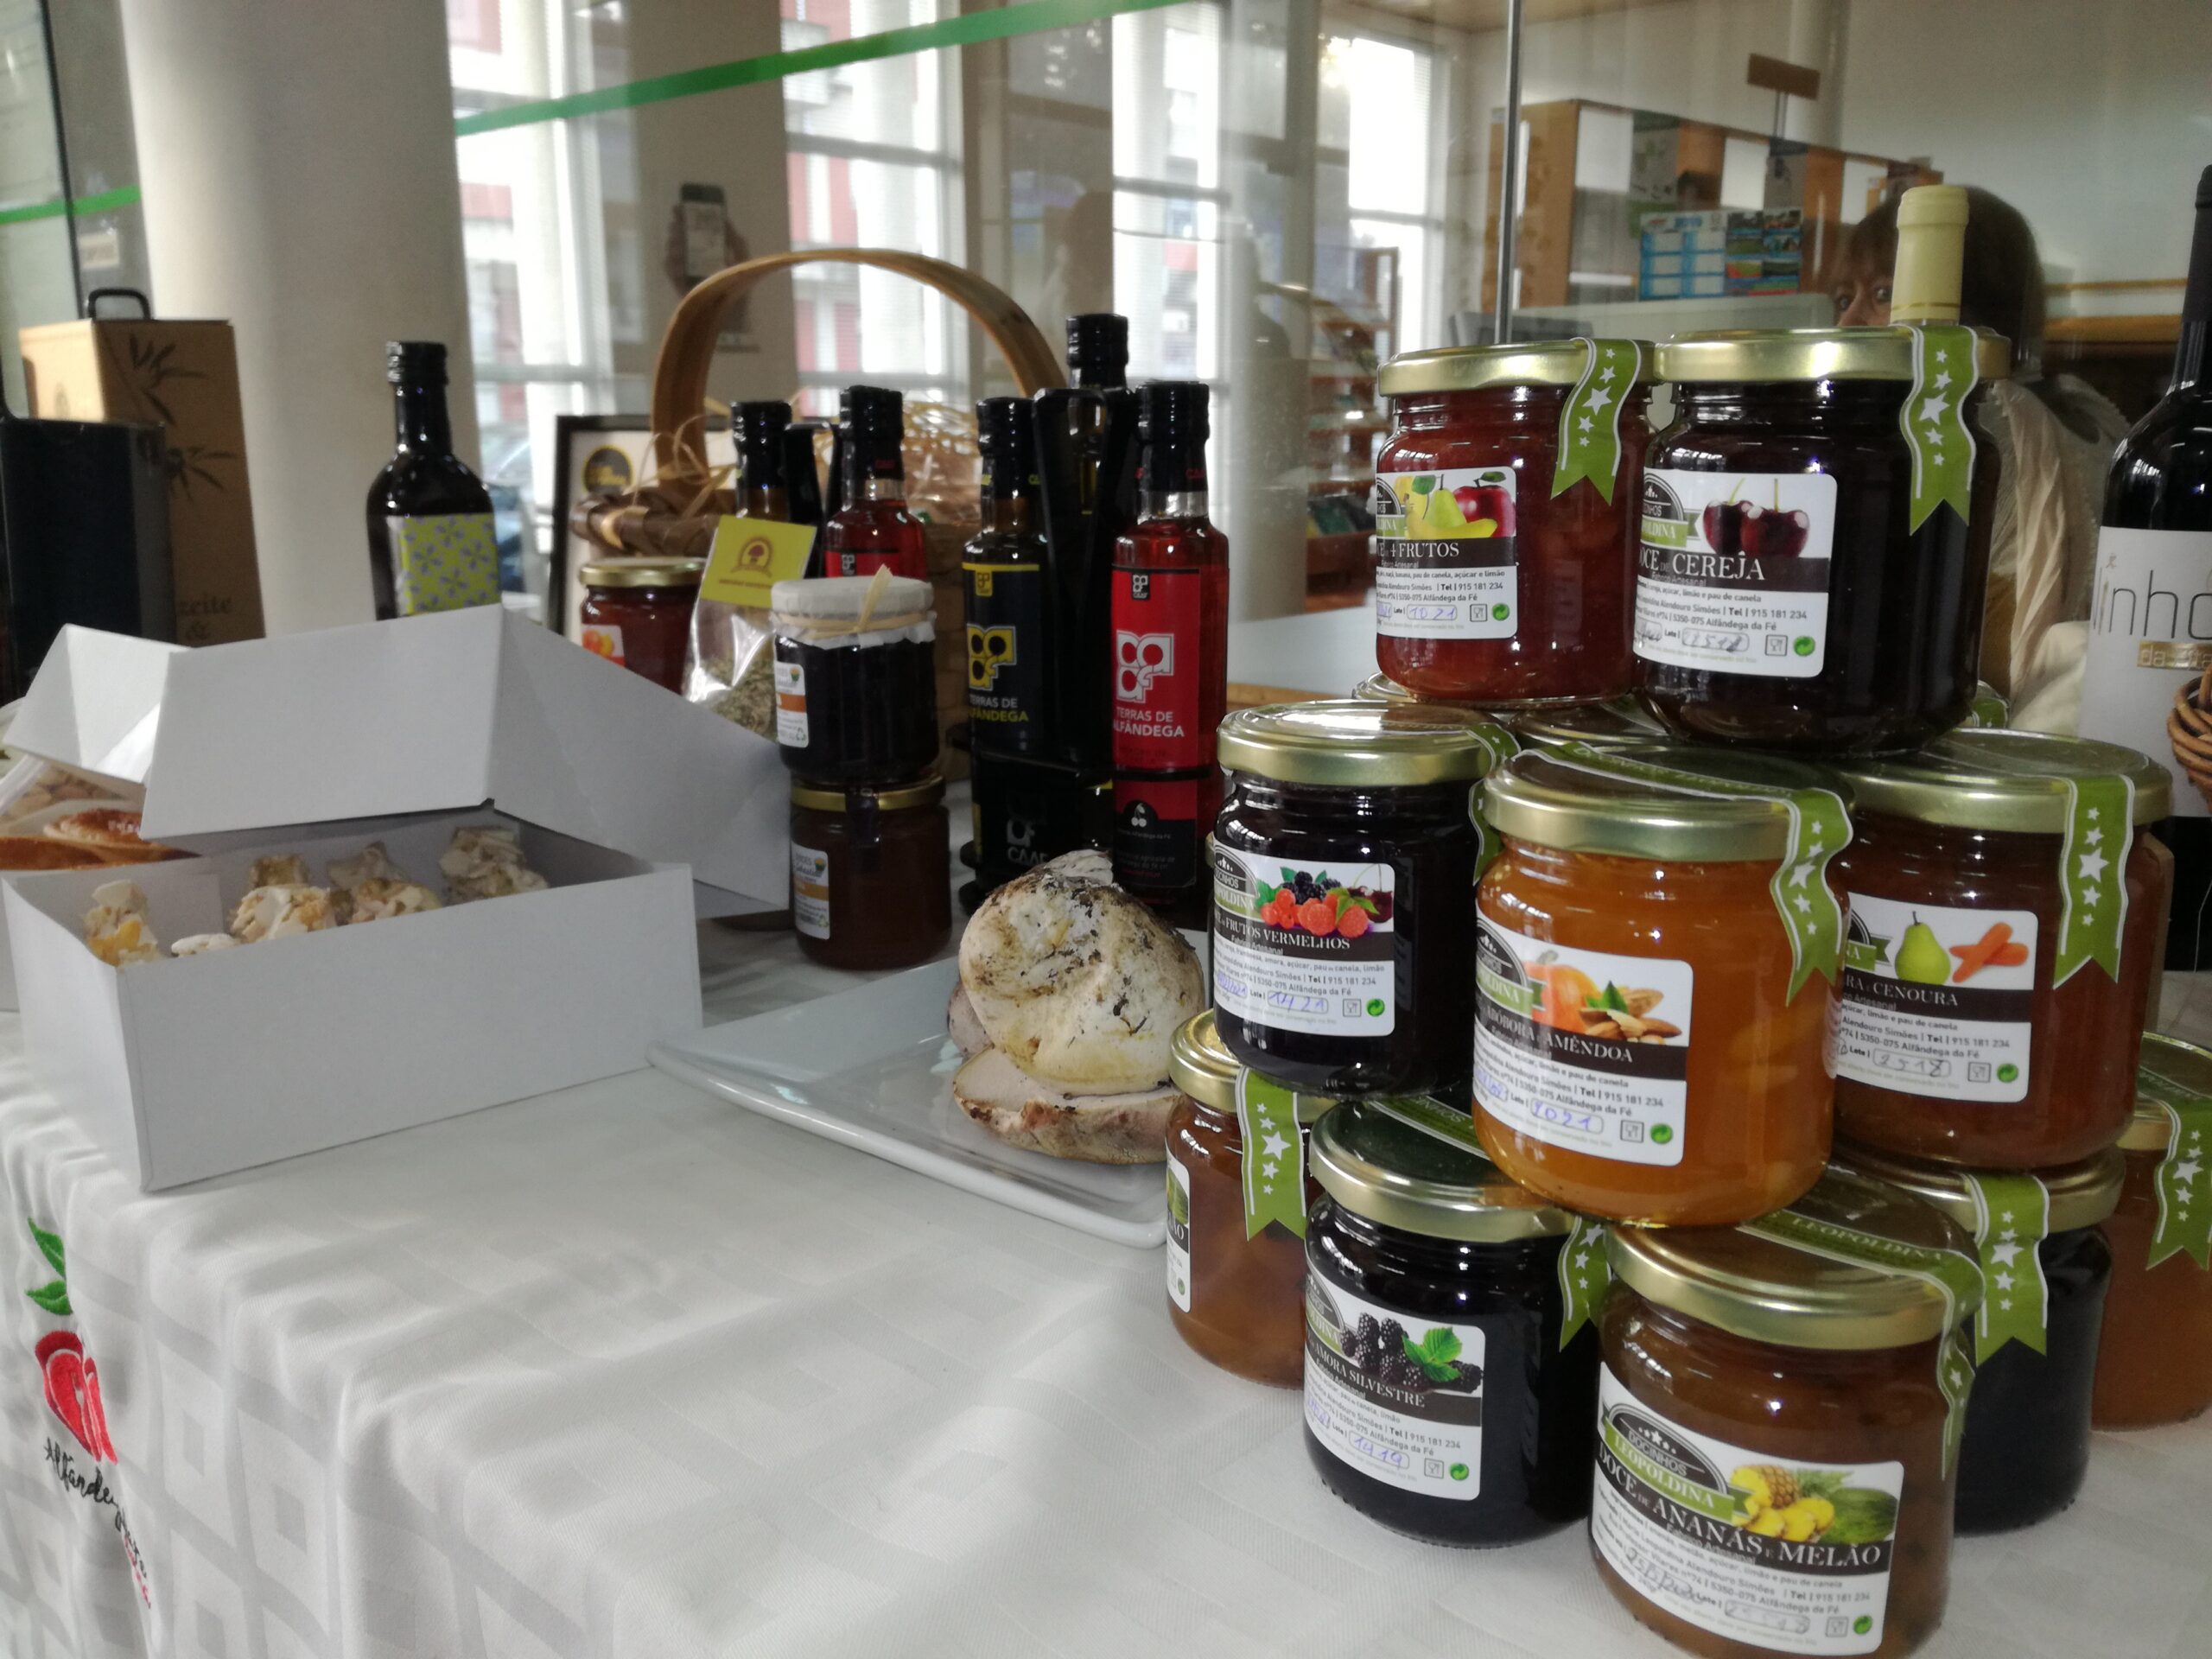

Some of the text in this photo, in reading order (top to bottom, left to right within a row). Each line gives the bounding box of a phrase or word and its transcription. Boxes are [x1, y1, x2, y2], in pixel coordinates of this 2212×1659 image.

[1399, 543, 1459, 558] FRUTOS
[1454, 569, 1477, 580] açúcar
[1484, 569, 1505, 577] limão
[1672, 552, 1765, 581] CEREJA
[1423, 594, 1456, 603] Alfândega
[1723, 592, 1732, 601] de
[1734, 594, 1762, 602] canela
[1693, 602, 1721, 615] Simões
[1729, 607, 1743, 616] Tel
[1751, 608, 1768, 617] 915
[1771, 609, 1786, 618] 181
[1789, 610, 1807, 620] 234
[1706, 617, 1749, 631] Alfândega
[1751, 621, 1762, 630] da
[1765, 621, 1777, 631] Fé
[1001, 697, 1018, 709] DE
[1116, 706, 1173, 722] TERRAS DE
[1225, 917, 1351, 950] FRUTOS VERMELHOS
[1275, 969, 1301, 982] Simões
[1308, 975, 1321, 983] Tel
[1328, 976, 1343, 984] 915
[1345, 976, 1359, 985] 181
[1362, 977, 1376, 986] 234
[1335, 963, 1362, 973] canela,
[1363, 963, 1384, 972] limão
[1288, 982, 1326, 995] Alfândega
[1329, 987, 1338, 995] da
[1341, 987, 1351, 995] Fé
[1873, 982, 1958, 1007] CENOURA
[1867, 1009, 1889, 1021] limão
[1897, 1017, 1912, 1027] pau
[1916, 1019, 1926, 1027] de
[1928, 1020, 1958, 1031] canela
[1545, 1033, 1633, 1063] AMÊNDOA
[1860, 1033, 1899, 1049] 5350-075
[1902, 1041, 1950, 1058] Alfândega
[1953, 1049, 1963, 1058] da
[1967, 1049, 1979, 1058] Fé
[1885, 1027, 1918, 1040] Simões
[1928, 1033, 1943, 1044] Tel
[1953, 1036, 1969, 1046] 915
[1974, 1038, 1989, 1047] 181
[1993, 1039, 2010, 1048] 234
[1849, 1045, 1866, 1056] Lote
[1541, 1074, 1572, 1092] Simões
[1580, 1086, 1595, 1097] Tel
[1605, 1091, 1622, 1103] 915
[1625, 1094, 1642, 1105] 181
[1645, 1096, 1663, 1107] 234
[1568, 1070, 1584, 1082] pau
[1586, 1073, 1596, 1084] de
[1598, 1076, 1628, 1089] canela
[1414, 1095, 1465, 1123] INHOS
[1556, 1094, 1603, 1113] Alfândega
[1605, 1103, 1617, 1114] da
[1619, 1104, 1631, 1116] Fé
[1792, 1217, 1942, 1262] LEOPOLDINA
[1314, 1343, 1426, 1408] AMORA SILVESTRE
[1381, 1410, 1401, 1424] limão
[1357, 1412, 1383, 1430] Simões
[1389, 1427, 1403, 1438] Tel
[1409, 1433, 1425, 1444] 915
[1428, 1436, 1442, 1446] 181
[1445, 1439, 1460, 1449] 234
[1370, 1430, 1409, 1451] Alfândega
[1411, 1444, 1421, 1452] da
[1423, 1446, 1433, 1456] Fé
[1627, 1429, 1687, 1477] DOCINHOS
[1613, 1433, 1715, 1510] LEOPOLDINA
[1599, 1442, 1638, 1501] DOCE
[1652, 1497, 1763, 1555] ANANÁS
[1777, 1539, 1881, 1567] MELÃO
[1738, 1577, 1775, 1596] Simões
[1789, 1590, 1807, 1600] Tel
[1758, 1597, 1809, 1614] Alfândega
[1812, 1605, 1824, 1614] da
[1827, 1605, 1839, 1614] Fé
